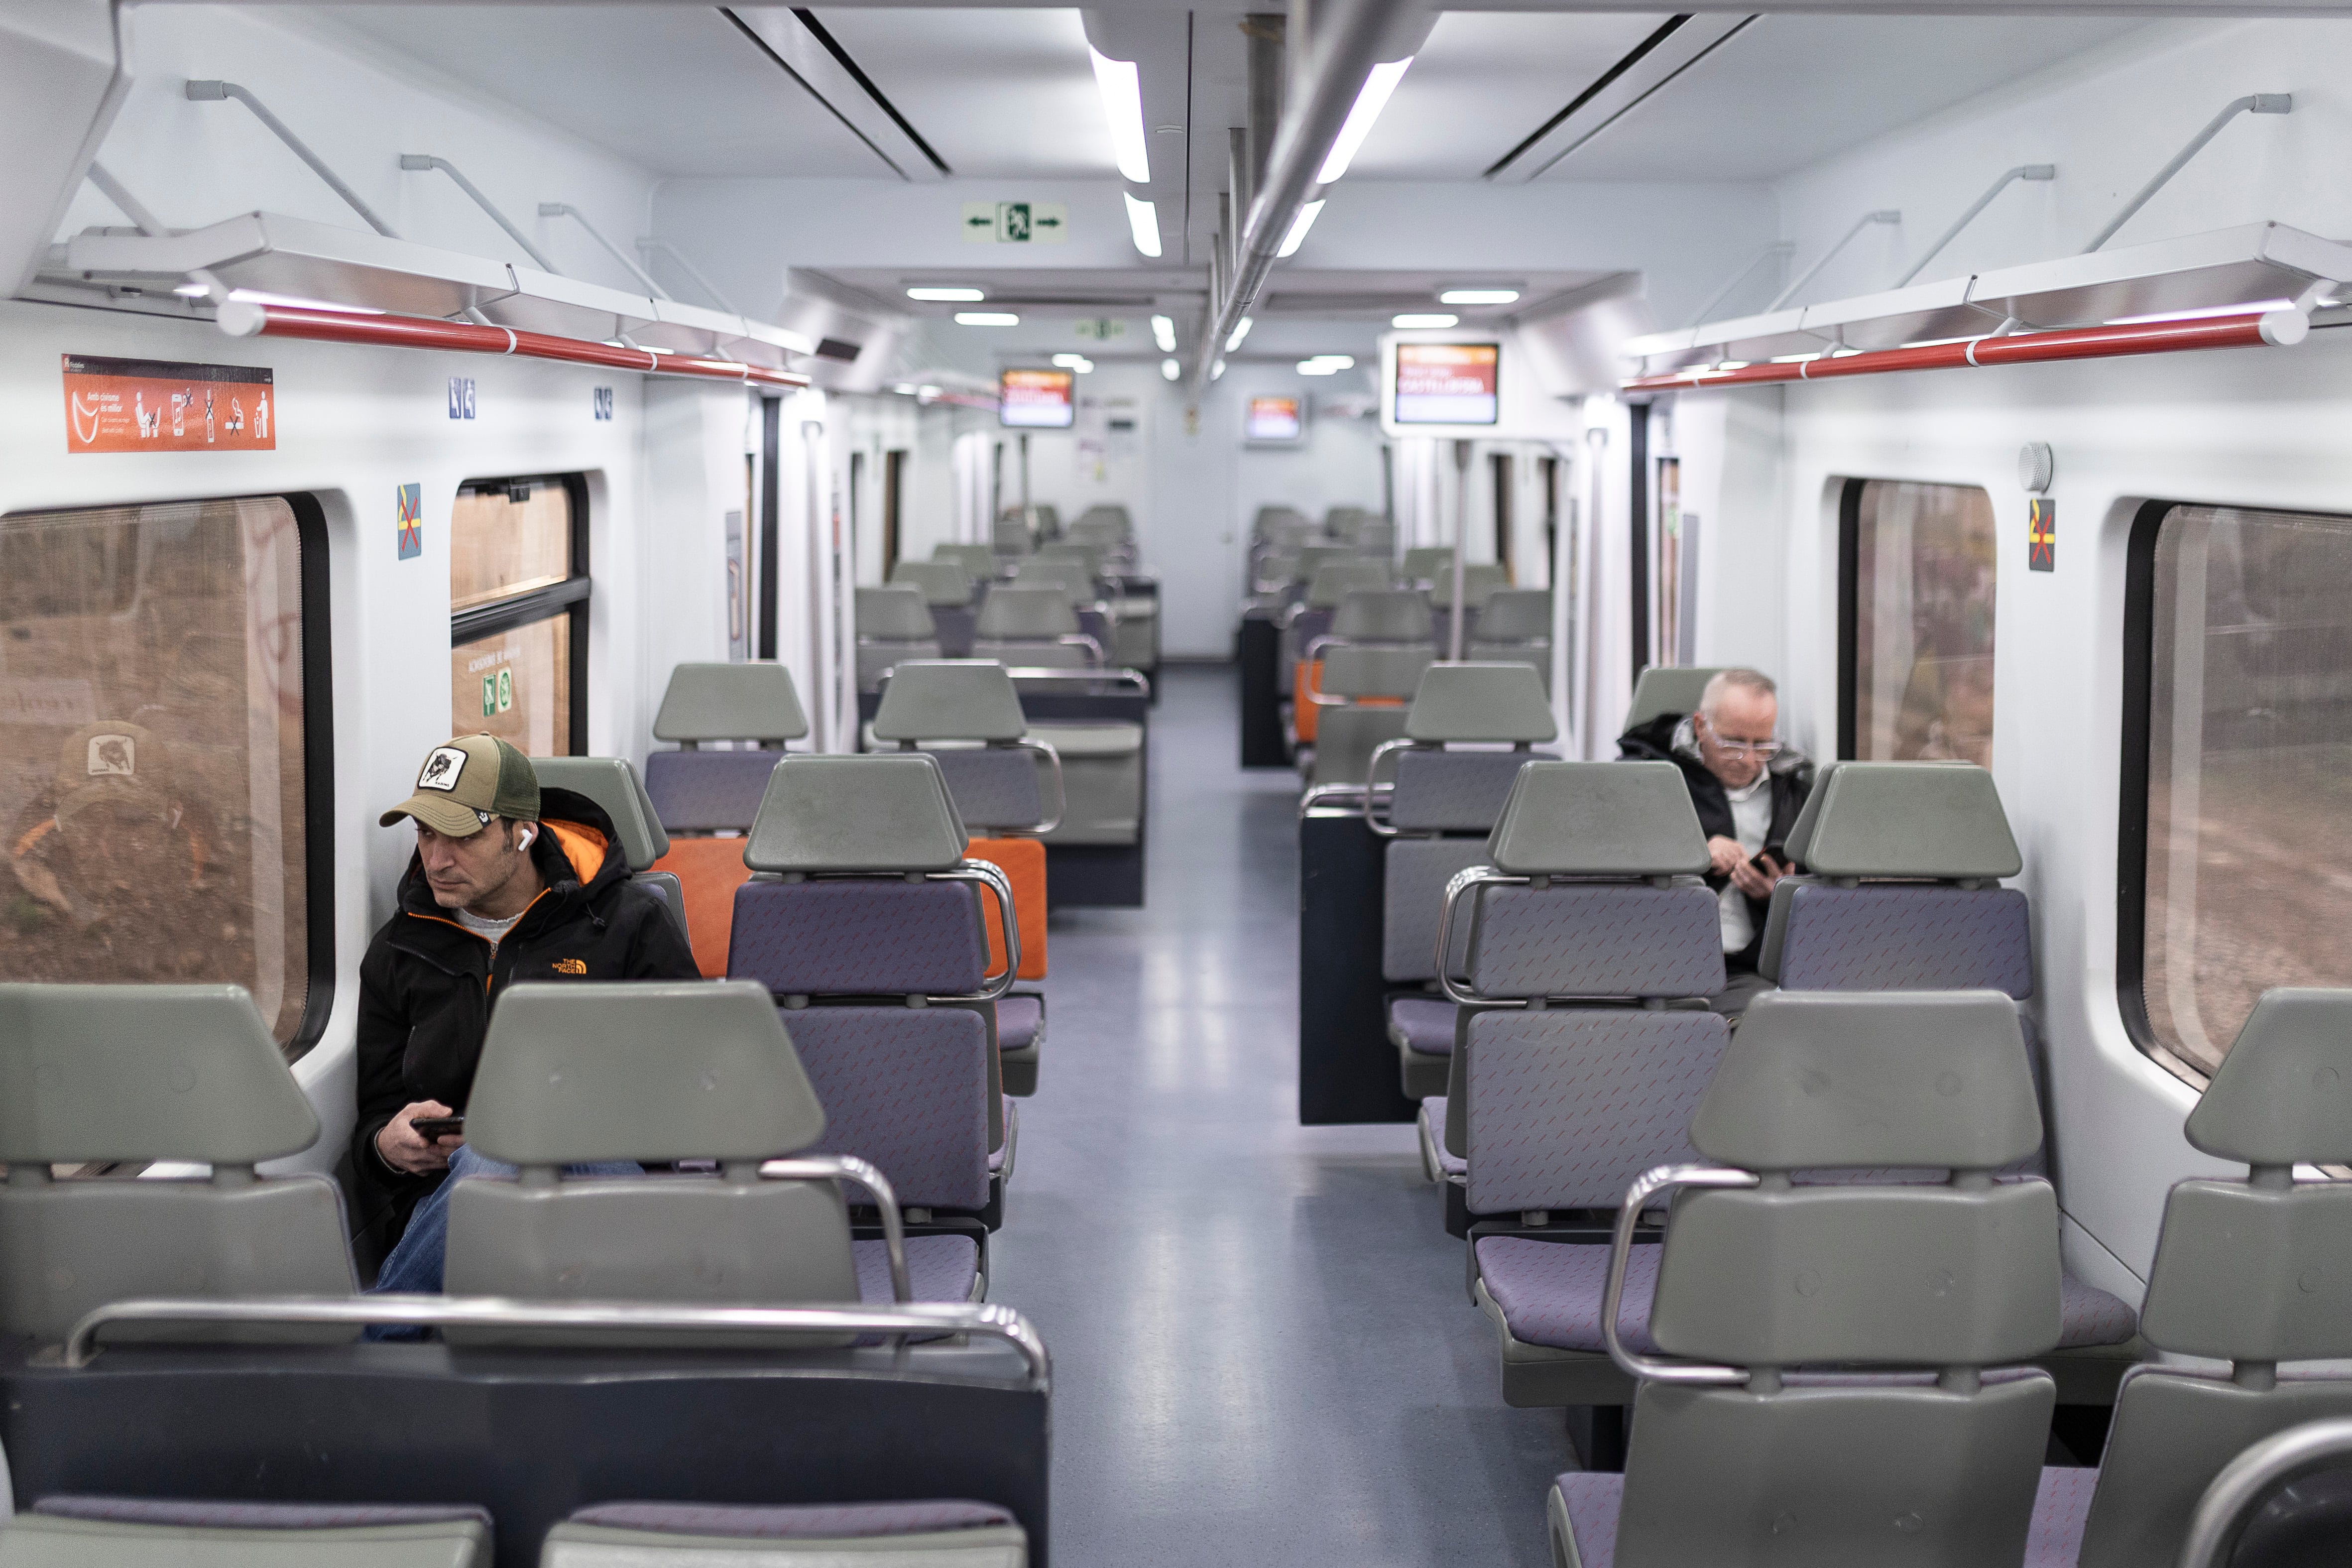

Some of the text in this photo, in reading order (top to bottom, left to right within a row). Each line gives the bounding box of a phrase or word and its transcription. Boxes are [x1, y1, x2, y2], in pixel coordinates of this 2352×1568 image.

[87, 392, 119, 401] Amb civisme
[101, 403, 122, 412] és millor
